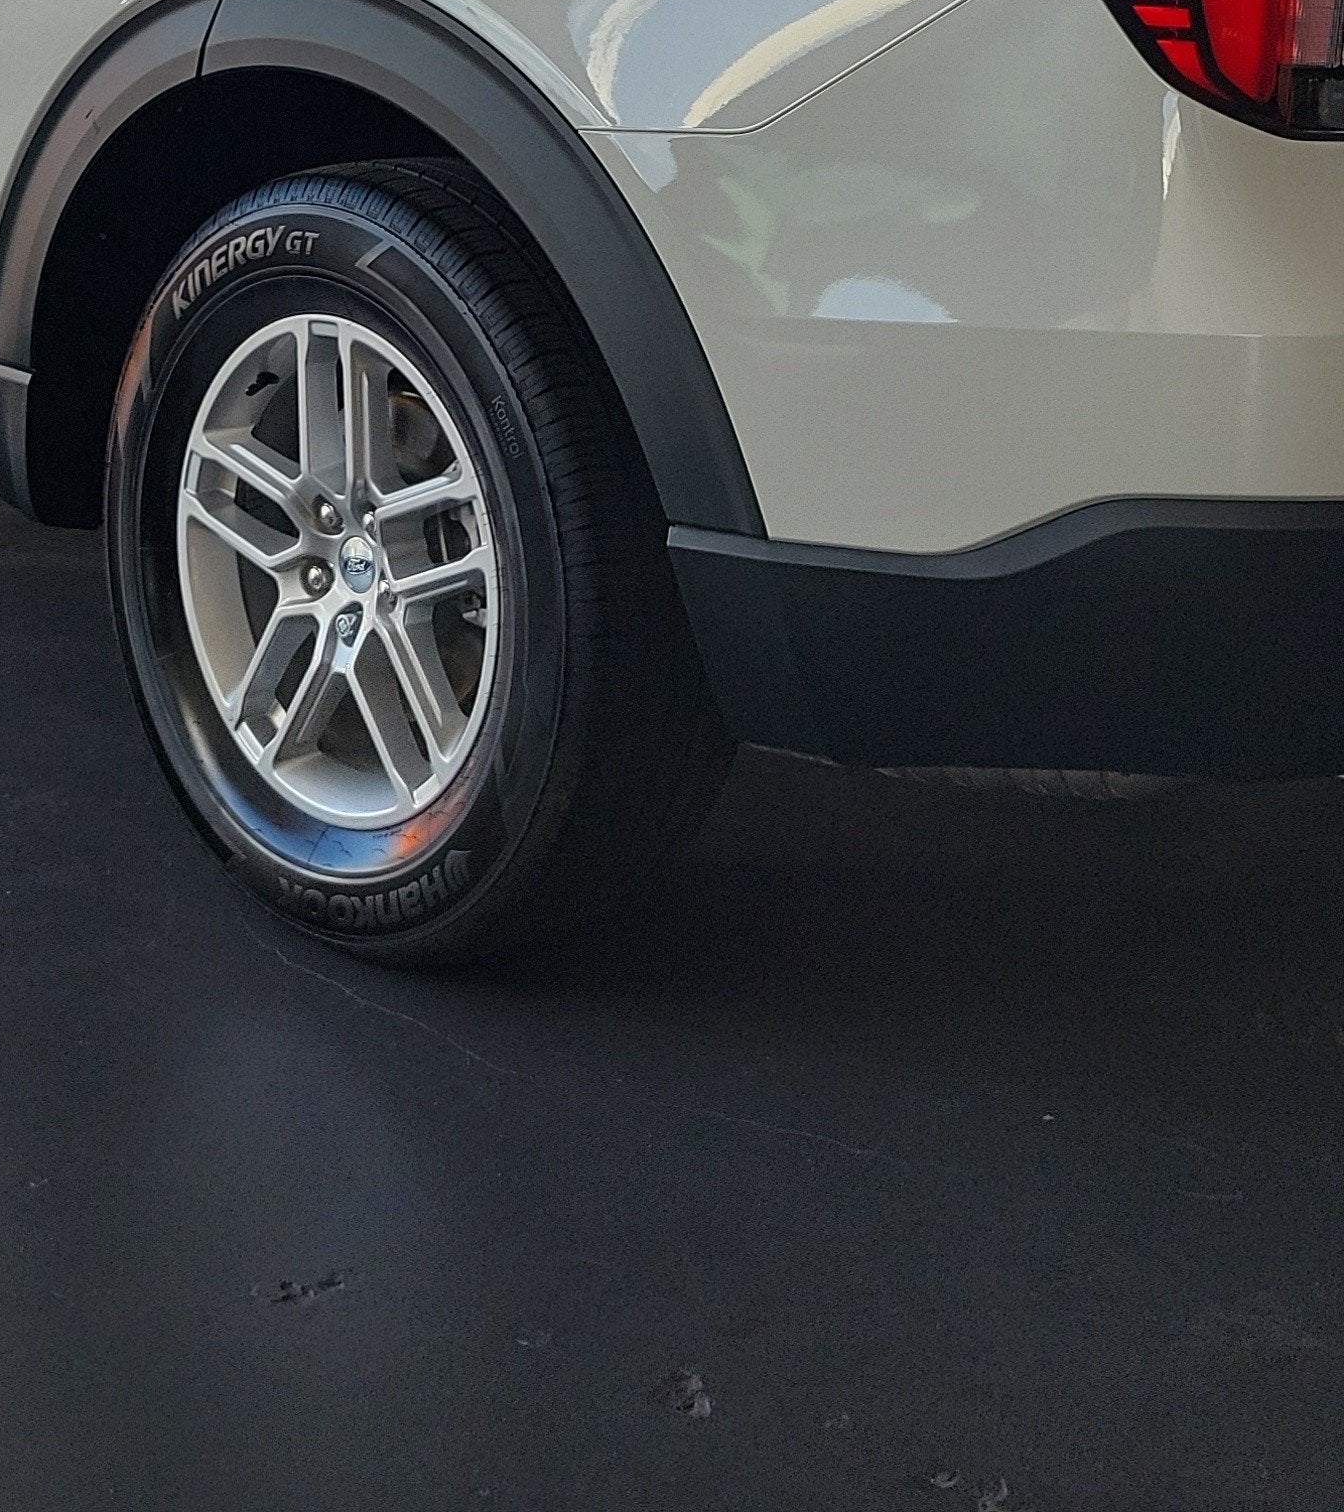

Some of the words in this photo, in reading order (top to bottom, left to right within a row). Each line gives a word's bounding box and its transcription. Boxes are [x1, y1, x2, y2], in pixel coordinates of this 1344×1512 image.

[172, 225, 286, 320] KINERGY
[284, 230, 320, 256] GT
[491, 395, 525, 459] Kontrol
